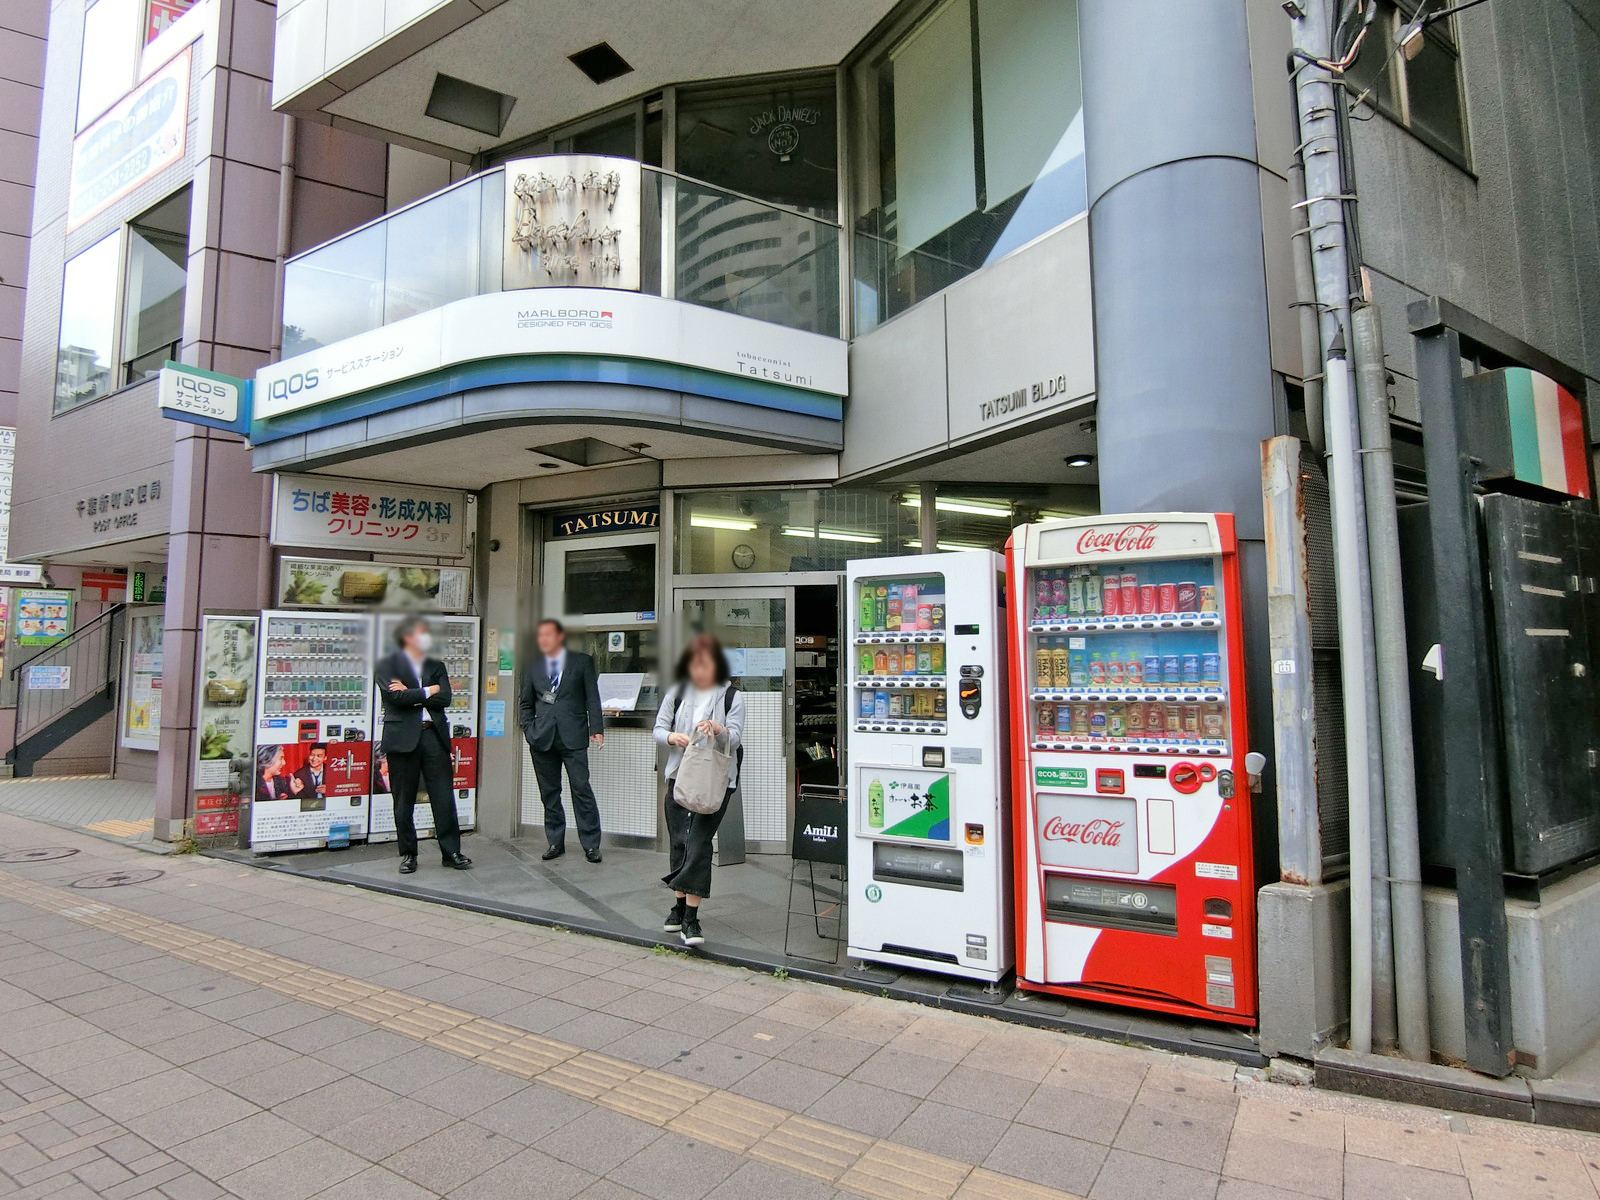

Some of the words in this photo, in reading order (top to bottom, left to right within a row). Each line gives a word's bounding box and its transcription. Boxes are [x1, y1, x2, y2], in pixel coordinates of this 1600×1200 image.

[517, 309, 600, 319] MARLBORO
[517, 320, 564, 329] DESIGNED
[567, 320, 587, 328] FOR
[737, 351, 792, 368] tobacconist
[268, 368, 320, 401] IQOS
[326, 346, 405, 379] サービスステーション
[737, 361, 813, 386] Tatsumi
[176, 376, 227, 398] IQOS
[176, 390, 210, 405] サービス
[979, 388, 1027, 421] TATSUMI
[1031, 374, 1066, 403] BLDG
[175, 398, 225, 416] ステーション
[292, 489, 452, 524] ちば美容・形成外科
[93, 518, 111, 533] POST
[114, 512, 138, 529] OFFICE
[327, 518, 419, 540] クリニック
[425, 526, 451, 543] 3F
[560, 510, 659, 535] TATSUMI
[1076, 523, 1159, 554] Coca-Cola
[1059, 658, 1067, 677] MAX
[803, 823, 838, 838] AmiLi
[1043, 816, 1125, 846] Coca-Cola
